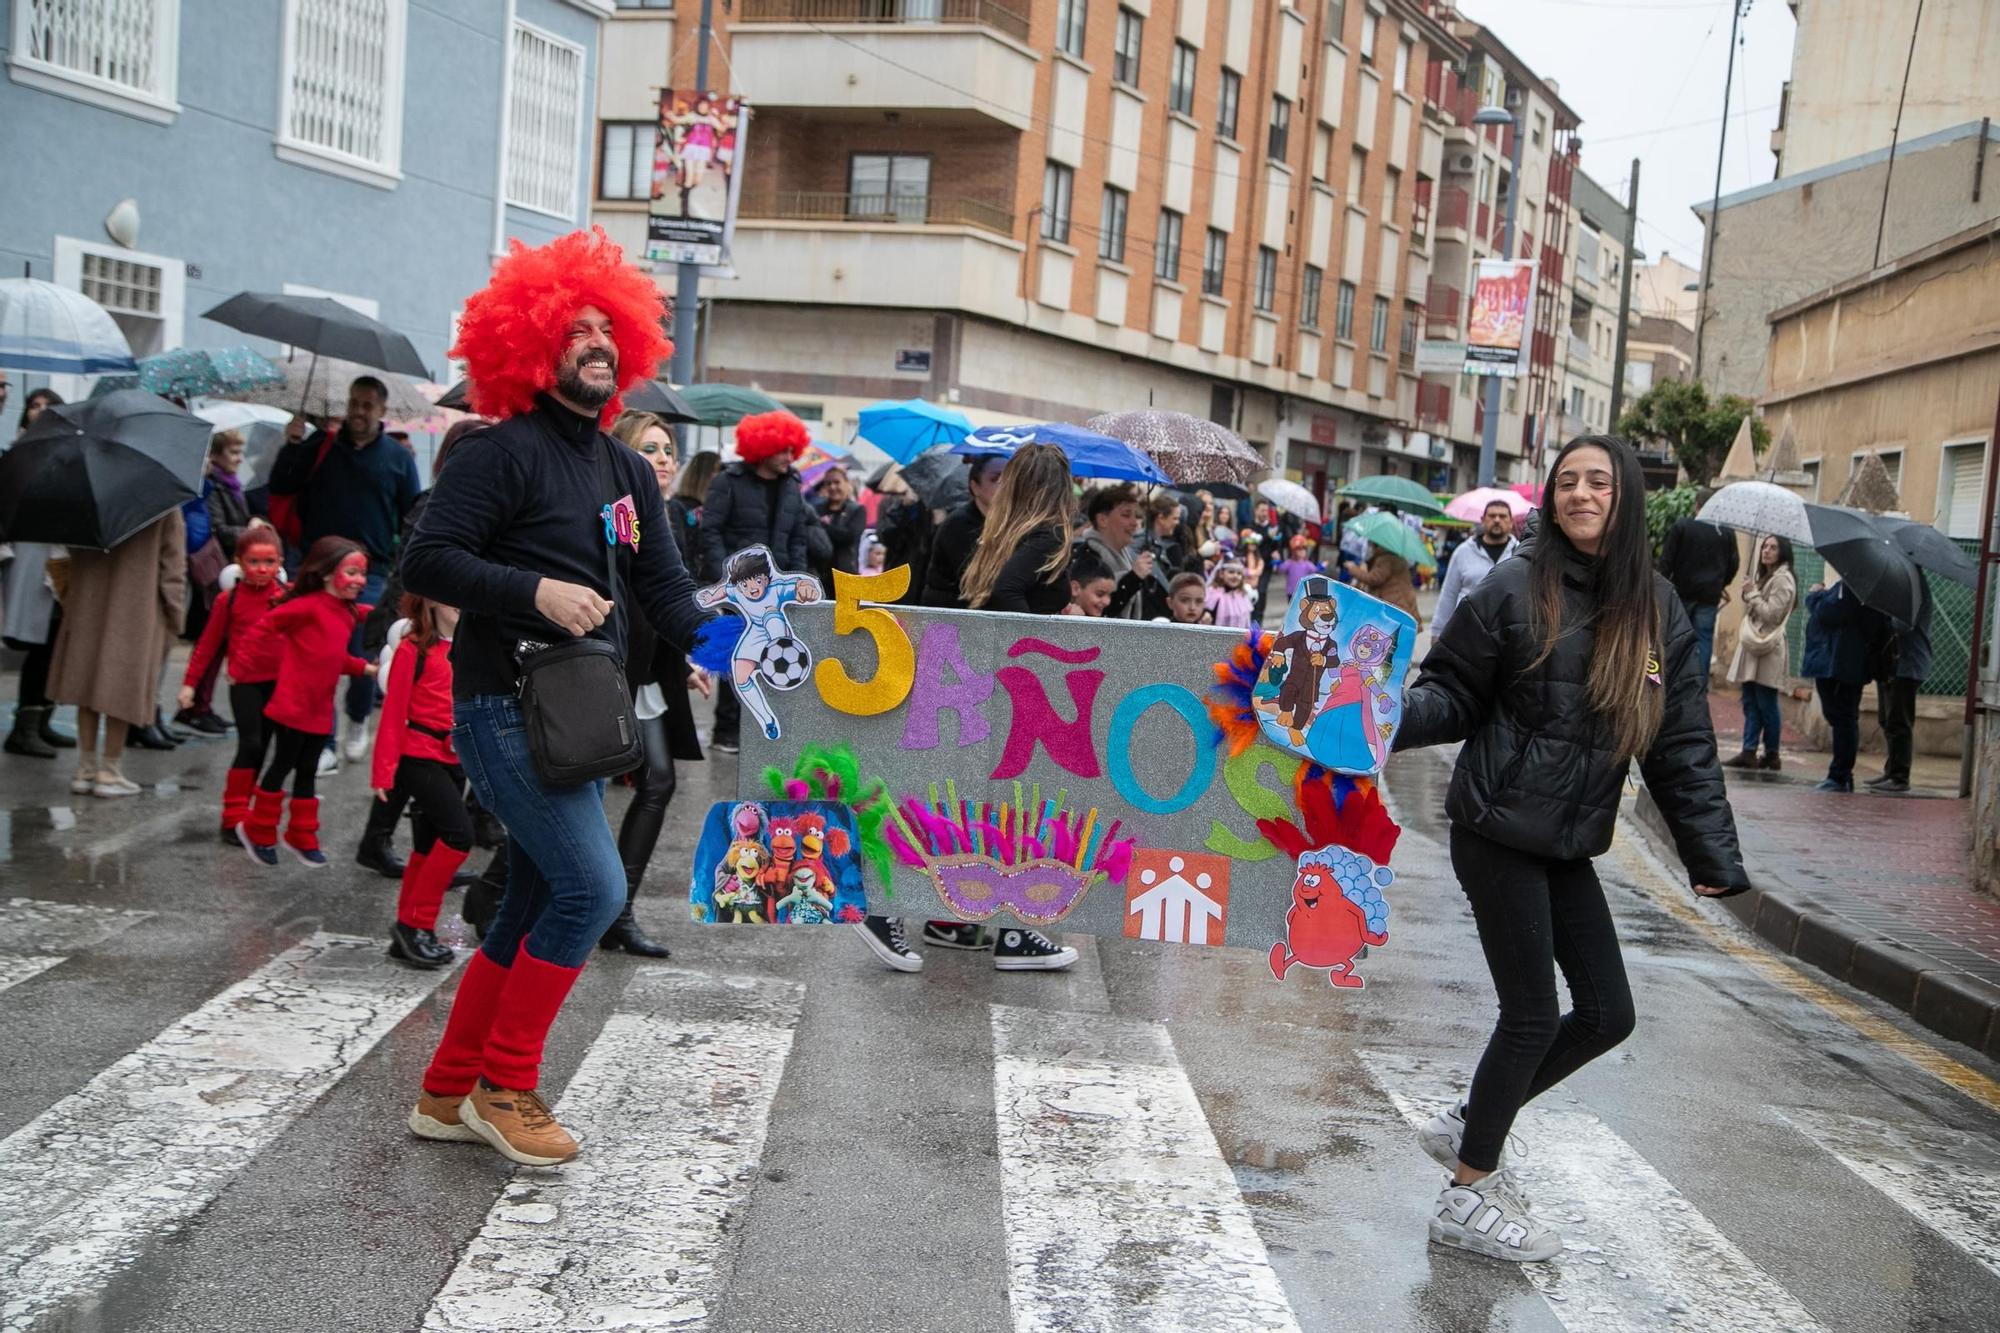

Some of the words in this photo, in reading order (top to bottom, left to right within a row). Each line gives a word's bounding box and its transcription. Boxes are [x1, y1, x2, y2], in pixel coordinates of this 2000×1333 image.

[603, 503, 641, 546] 80's
[814, 563, 915, 716] 5
[900, 621, 1300, 862] AÑOS
[1436, 1186, 1529, 1249] AIR
